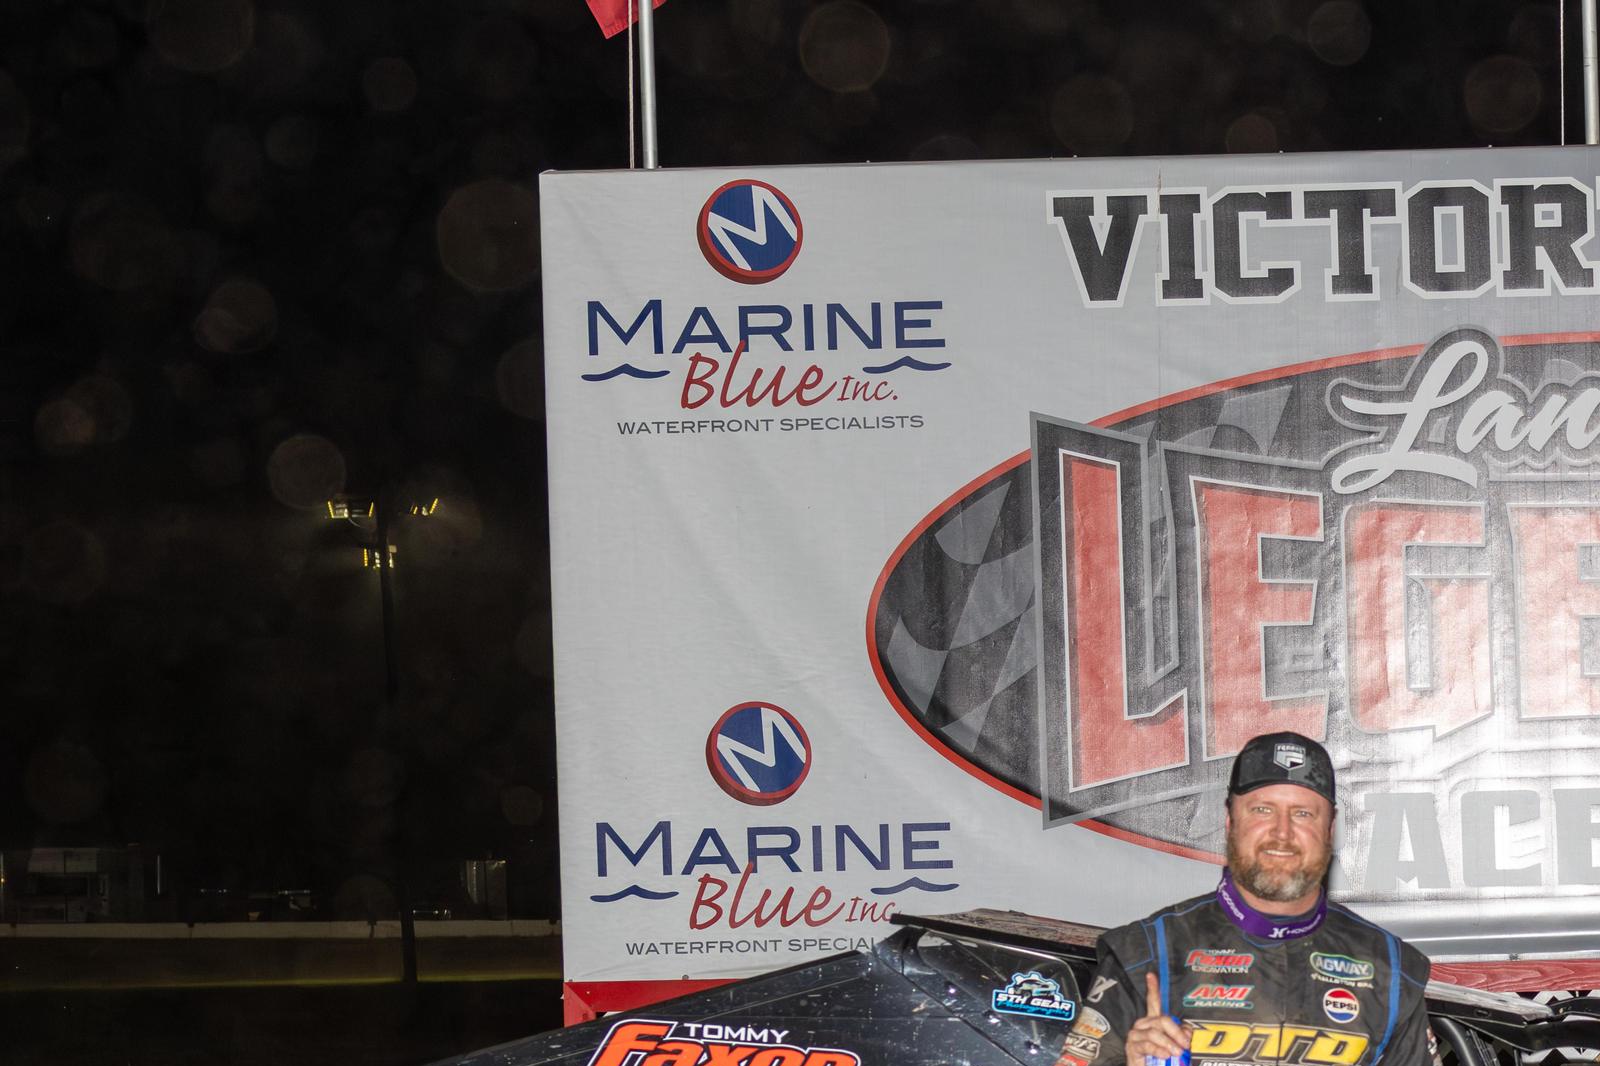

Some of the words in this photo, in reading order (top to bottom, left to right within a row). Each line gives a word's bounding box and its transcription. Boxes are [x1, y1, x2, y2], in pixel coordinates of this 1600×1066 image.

[587, 299, 946, 356] MARINE
[681, 341, 836, 410] Blue
[837, 375, 898, 402] Inc.
[616, 418, 775, 436] WATERFRONT
[780, 415, 924, 433] SPECIALISTS
[596, 820, 954, 877] MARINE
[689, 862, 845, 930] Blue
[845, 896, 901, 923] Inc
[626, 937, 783, 956] WATERFRONT
[787, 936, 892, 952] SPECIAL
[1315, 956, 1370, 976] AGWAY
[1187, 985, 1254, 1000] AMI
[1030, 998, 1072, 1011] GEAR
[1325, 999, 1357, 1011] PEPSI
[683, 1022, 791, 1045] TOMMY
[1187, 1022, 1369, 1066] DTD
